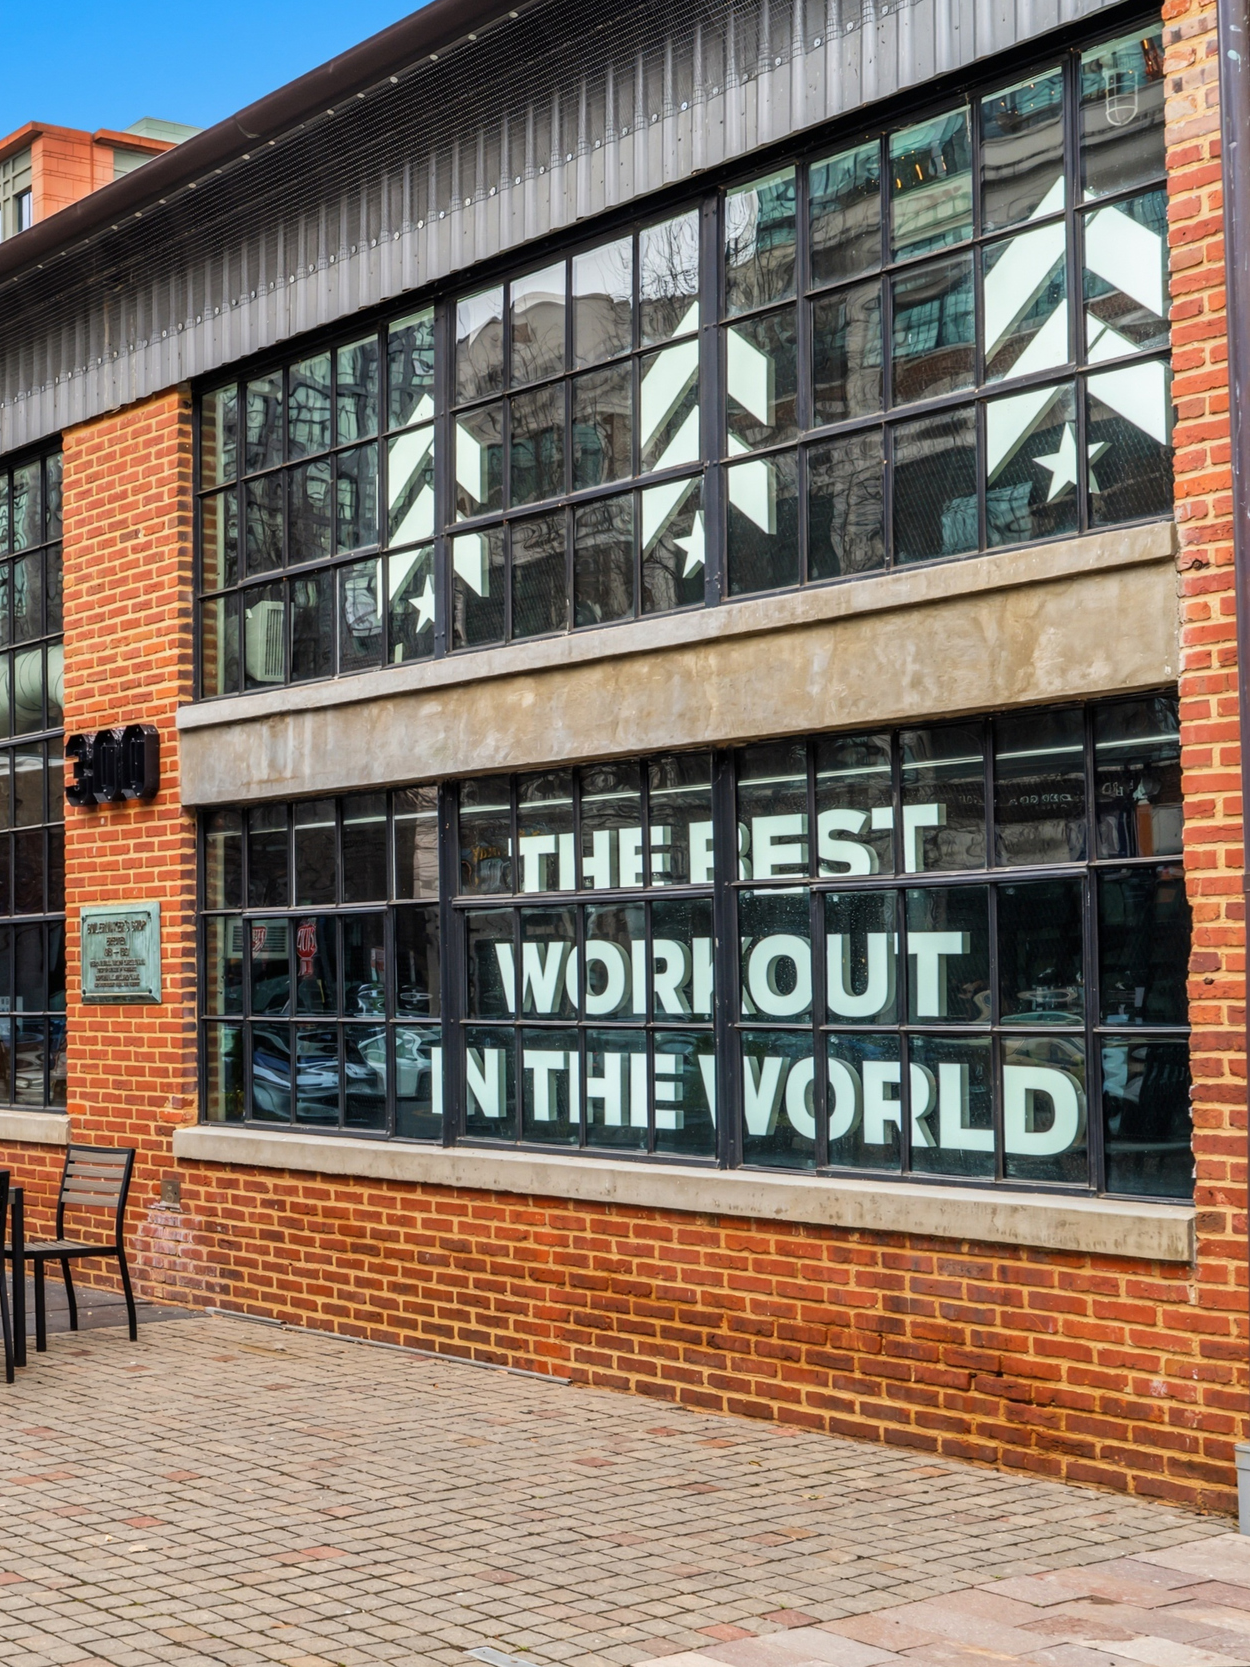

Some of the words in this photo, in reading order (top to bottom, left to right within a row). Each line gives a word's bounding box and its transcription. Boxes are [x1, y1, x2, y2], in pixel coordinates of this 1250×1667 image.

[66, 724, 160, 807] 300
[508, 824, 671, 892] THE
[689, 803, 946, 895] BEST
[495, 930, 971, 1017] WORKOUT
[431, 1046, 506, 1118] IN
[523, 1050, 684, 1130] THE
[698, 1054, 1086, 1156] WORLD
